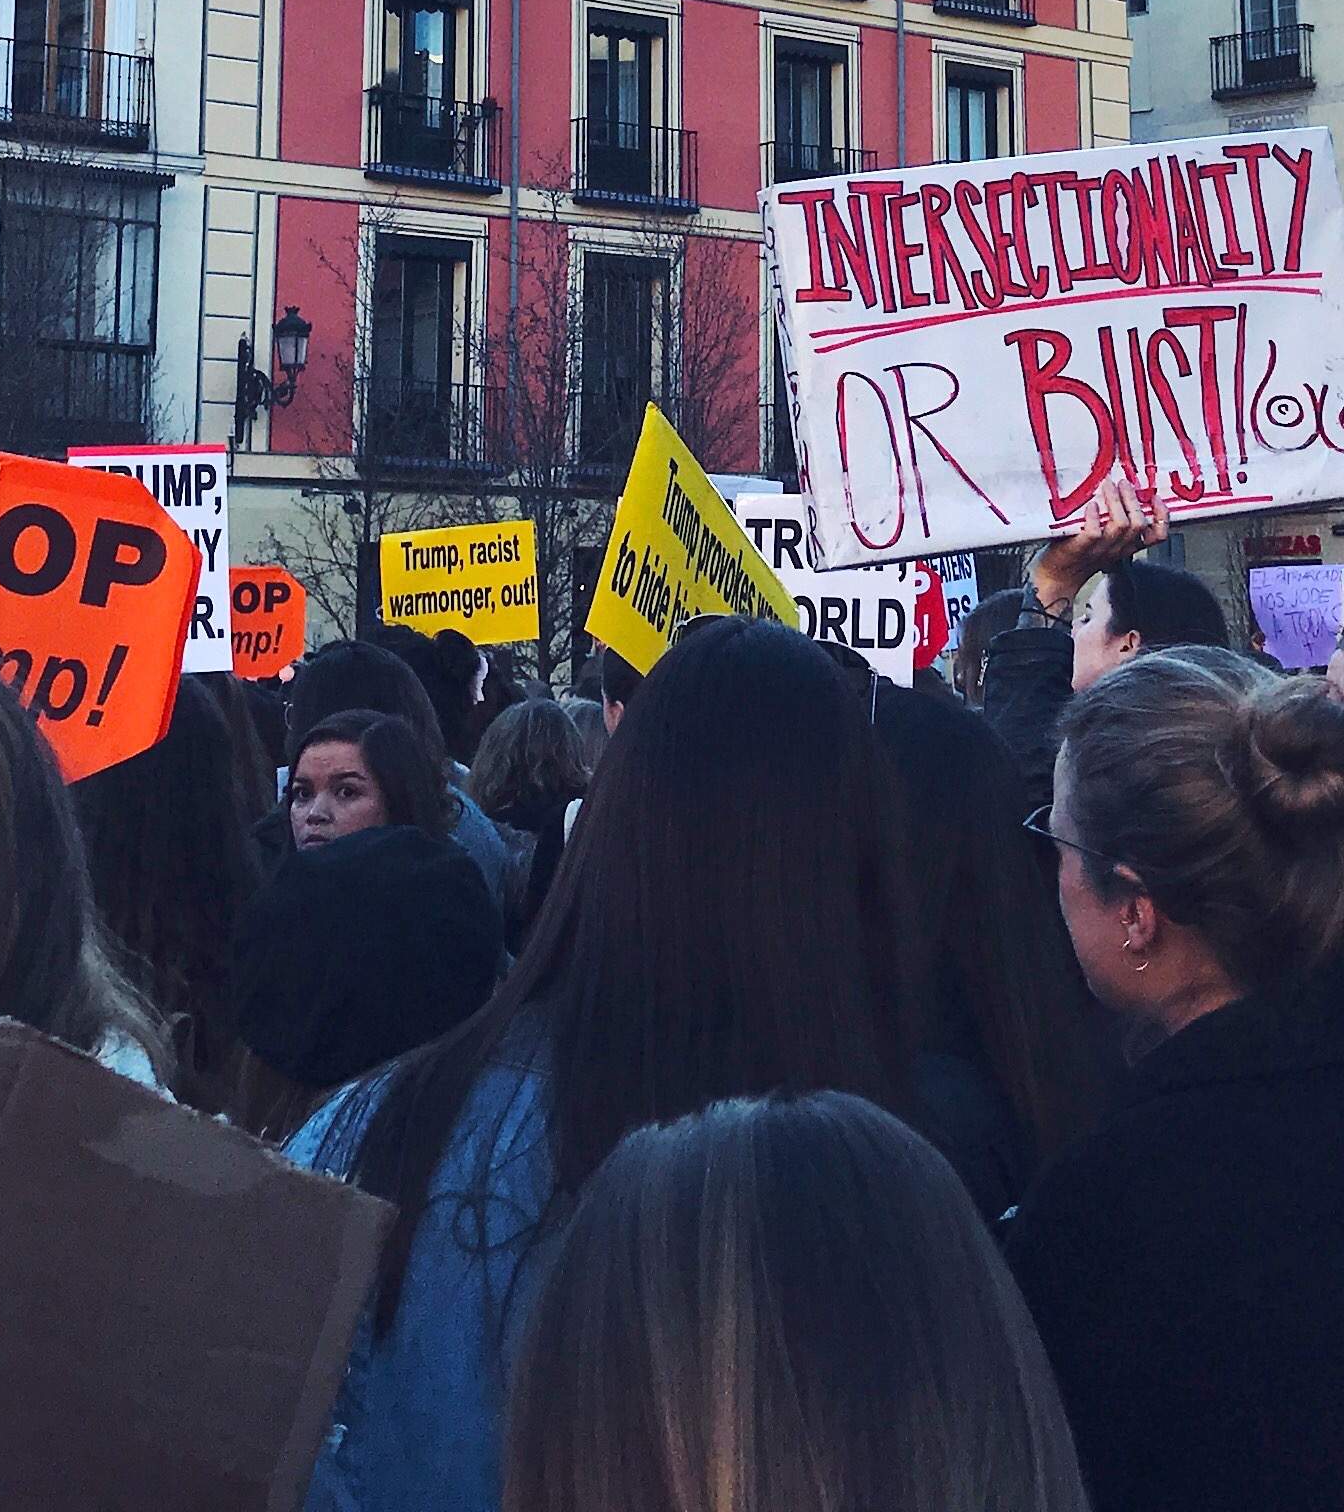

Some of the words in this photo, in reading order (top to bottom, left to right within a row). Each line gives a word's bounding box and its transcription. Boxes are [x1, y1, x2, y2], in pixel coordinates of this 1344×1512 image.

[777, 142, 1313, 314] INTERSECTIONALITY
[836, 362, 1011, 551] OR
[1003, 302, 1250, 522] BUST!
[81, 463, 223, 515] UMP,
[662, 457, 701, 570] Trump
[400, 541, 465, 575] Trump,
[469, 533, 521, 565] racist
[232, 581, 292, 614] OP
[389, 586, 496, 619] warmonger,
[501, 575, 537, 608] out!
[611, 529, 636, 599] to
[631, 544, 671, 634] hide
[231, 623, 284, 663] mp!
[790, 595, 907, 649] ORLD
